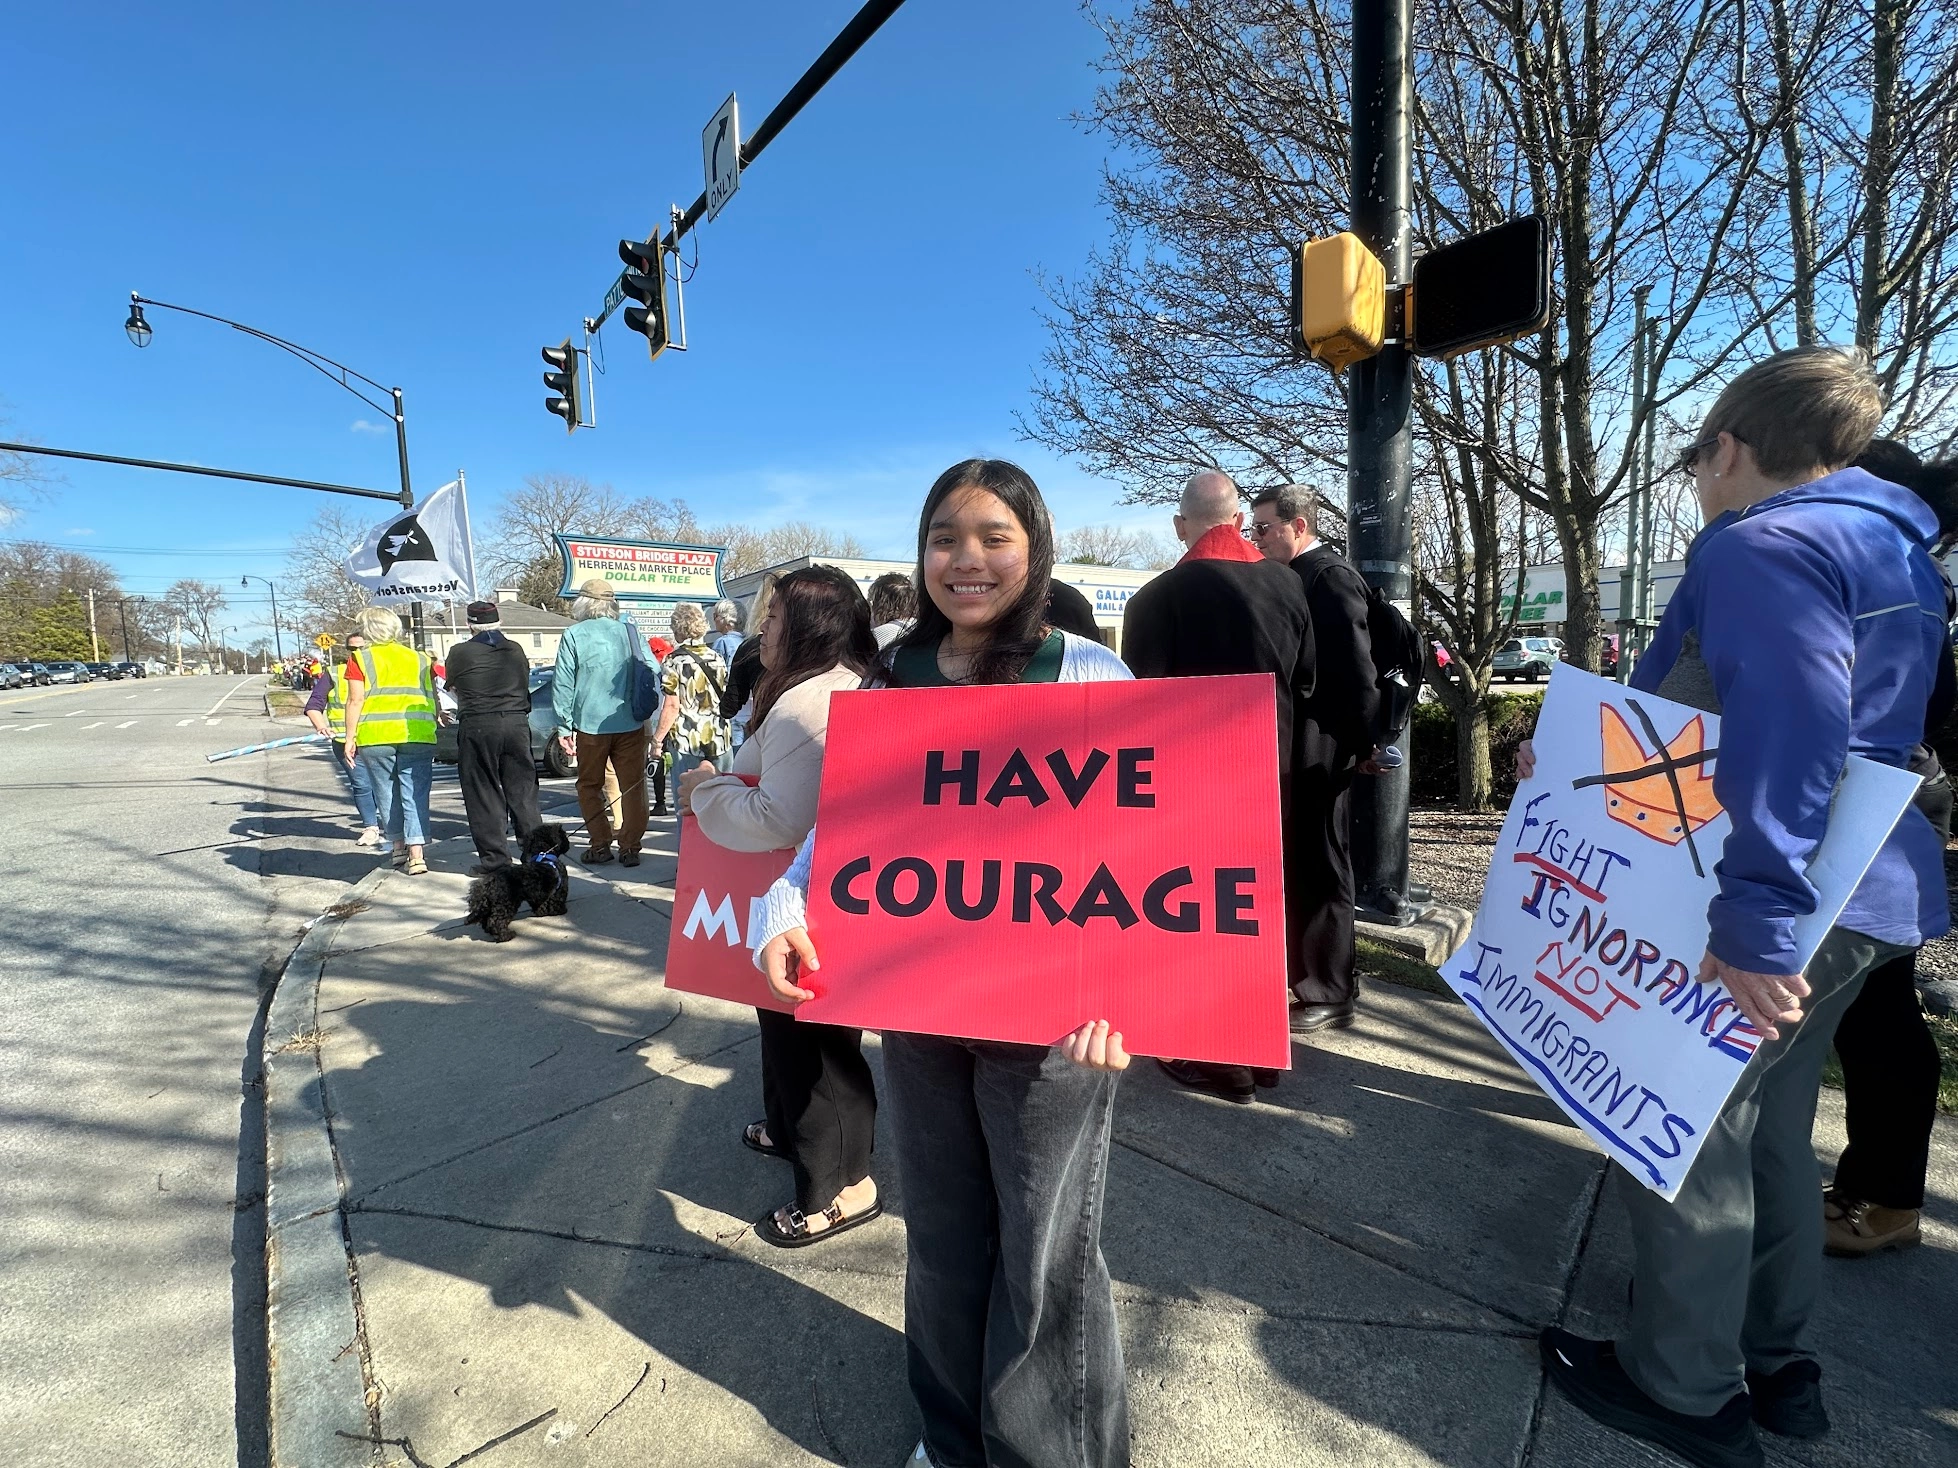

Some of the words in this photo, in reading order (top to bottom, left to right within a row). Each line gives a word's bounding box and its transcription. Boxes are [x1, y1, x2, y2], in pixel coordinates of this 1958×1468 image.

[711, 168, 733, 209] ONLY
[577, 546, 632, 560] STUTSON
[635, 551, 676, 563] BRIDGE
[679, 554, 712, 565] PLAZA
[579, 560, 636, 571] HERREMAS
[640, 564, 678, 574] MARKET
[682, 566, 711, 575] PLACE
[605, 572, 655, 582] DOLLAR
[662, 574, 691, 584] TREE
[1096, 602, 1117, 611] NAIL
[1118, 603, 1124, 612] &
[1500, 591, 1563, 608] OLLAR
[922, 746, 1156, 810] HAVE
[1516, 792, 1631, 894] FIGHT
[830, 854, 1261, 938] COURAGE
[1521, 870, 1764, 1065] IGNORANCE
[1536, 941, 1641, 1017] NOT
[1459, 941, 1695, 1159] IMMIGRANTS
